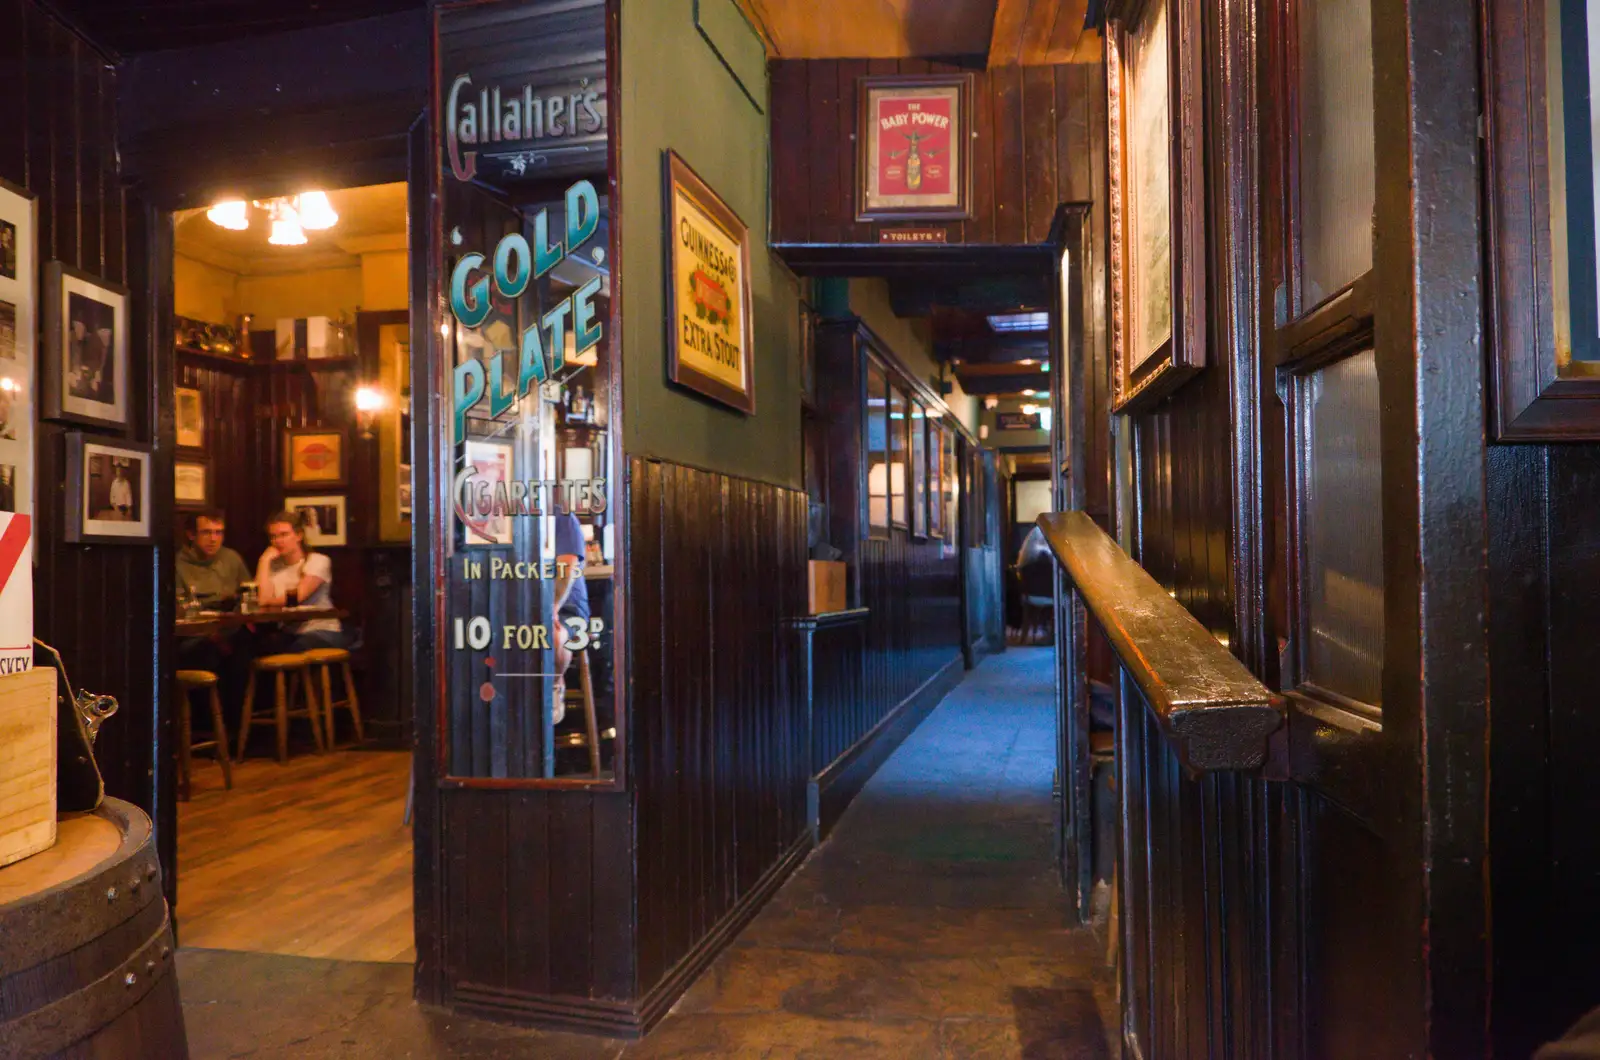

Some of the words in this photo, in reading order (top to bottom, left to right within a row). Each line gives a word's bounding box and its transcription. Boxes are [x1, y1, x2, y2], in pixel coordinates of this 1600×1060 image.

[880, 112, 909, 131] BABY
[911, 111, 949, 130] POWER
[907, 103, 921, 111] THE
[451, 180, 600, 328] GOLD
[890, 232, 933, 241] TOILETS
[683, 313, 713, 360] EXTRA
[713, 331, 740, 372] STOUT
[452, 275, 603, 447] PLATE
[453, 465, 607, 543] CIGARETTES
[464, 558, 482, 580] IN
[491, 557, 583, 580] PACKETS
[454, 615, 491, 650] 10
[503, 624, 550, 650] FOR
